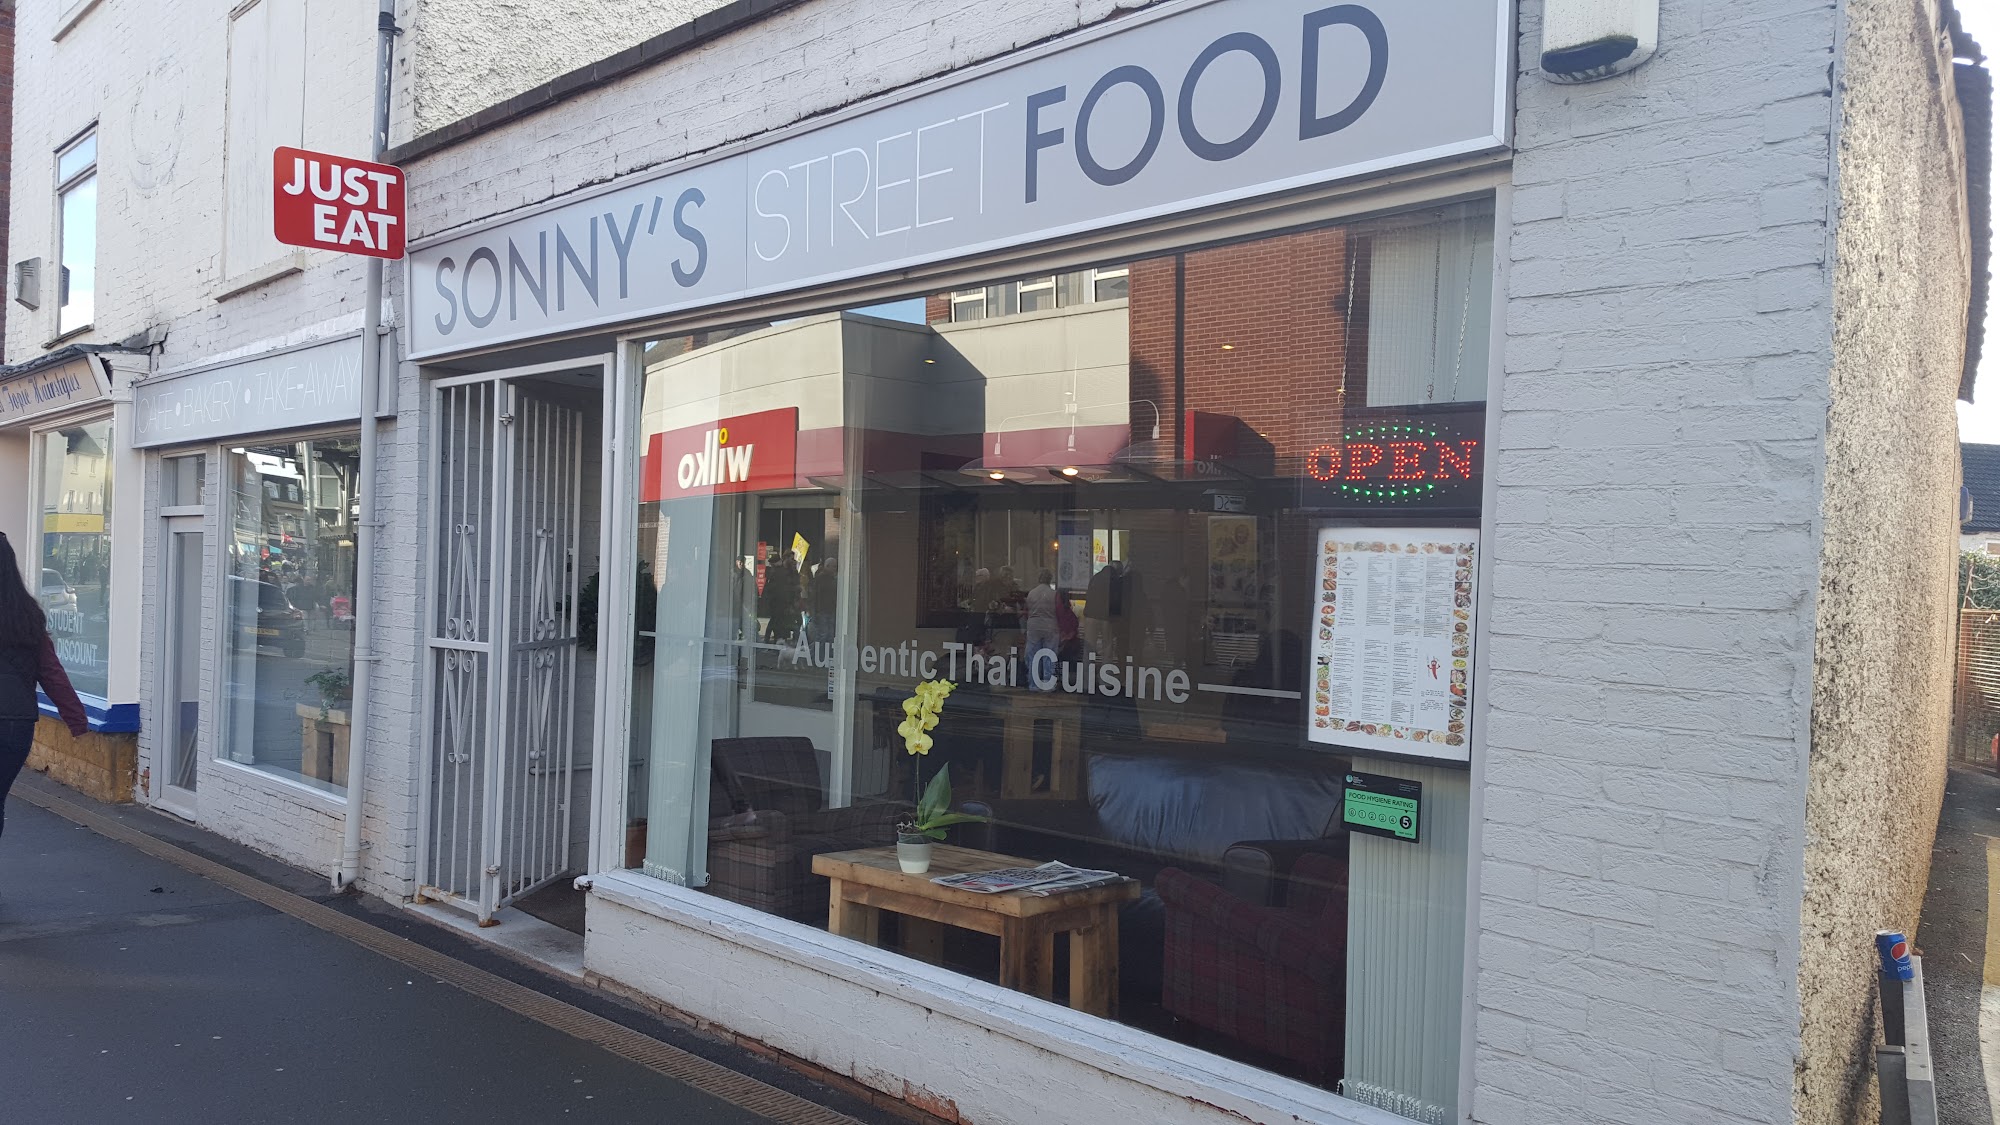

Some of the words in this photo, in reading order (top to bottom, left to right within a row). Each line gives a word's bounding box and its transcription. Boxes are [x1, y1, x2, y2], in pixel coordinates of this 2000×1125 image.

[283, 158, 396, 210] JUST
[434, 187, 708, 336] SONNY'S
[754, 102, 1010, 261] STREET
[1025, 4, 1389, 204] FOOD
[314, 204, 397, 250] EAT
[28, 365, 81, 404] Hairstyles
[183, 378, 242, 427] BAKERY
[256, 352, 361, 415] TAKE-AWAY
[1307, 442, 1478, 482] OPEN
[48, 608, 84, 634] STUDENT
[57, 638, 97, 666] DISCOUNT
[792, 631, 937, 680] Auentic
[943, 641, 1017, 687] Thai
[1031, 646, 1190, 703] Cuisine
[1349, 792, 1366, 800] FOOD
[1367, 796, 1391, 805] HYGIENE
[1392, 800, 1413, 809] RATING
[1402, 817, 1410, 828] 5
